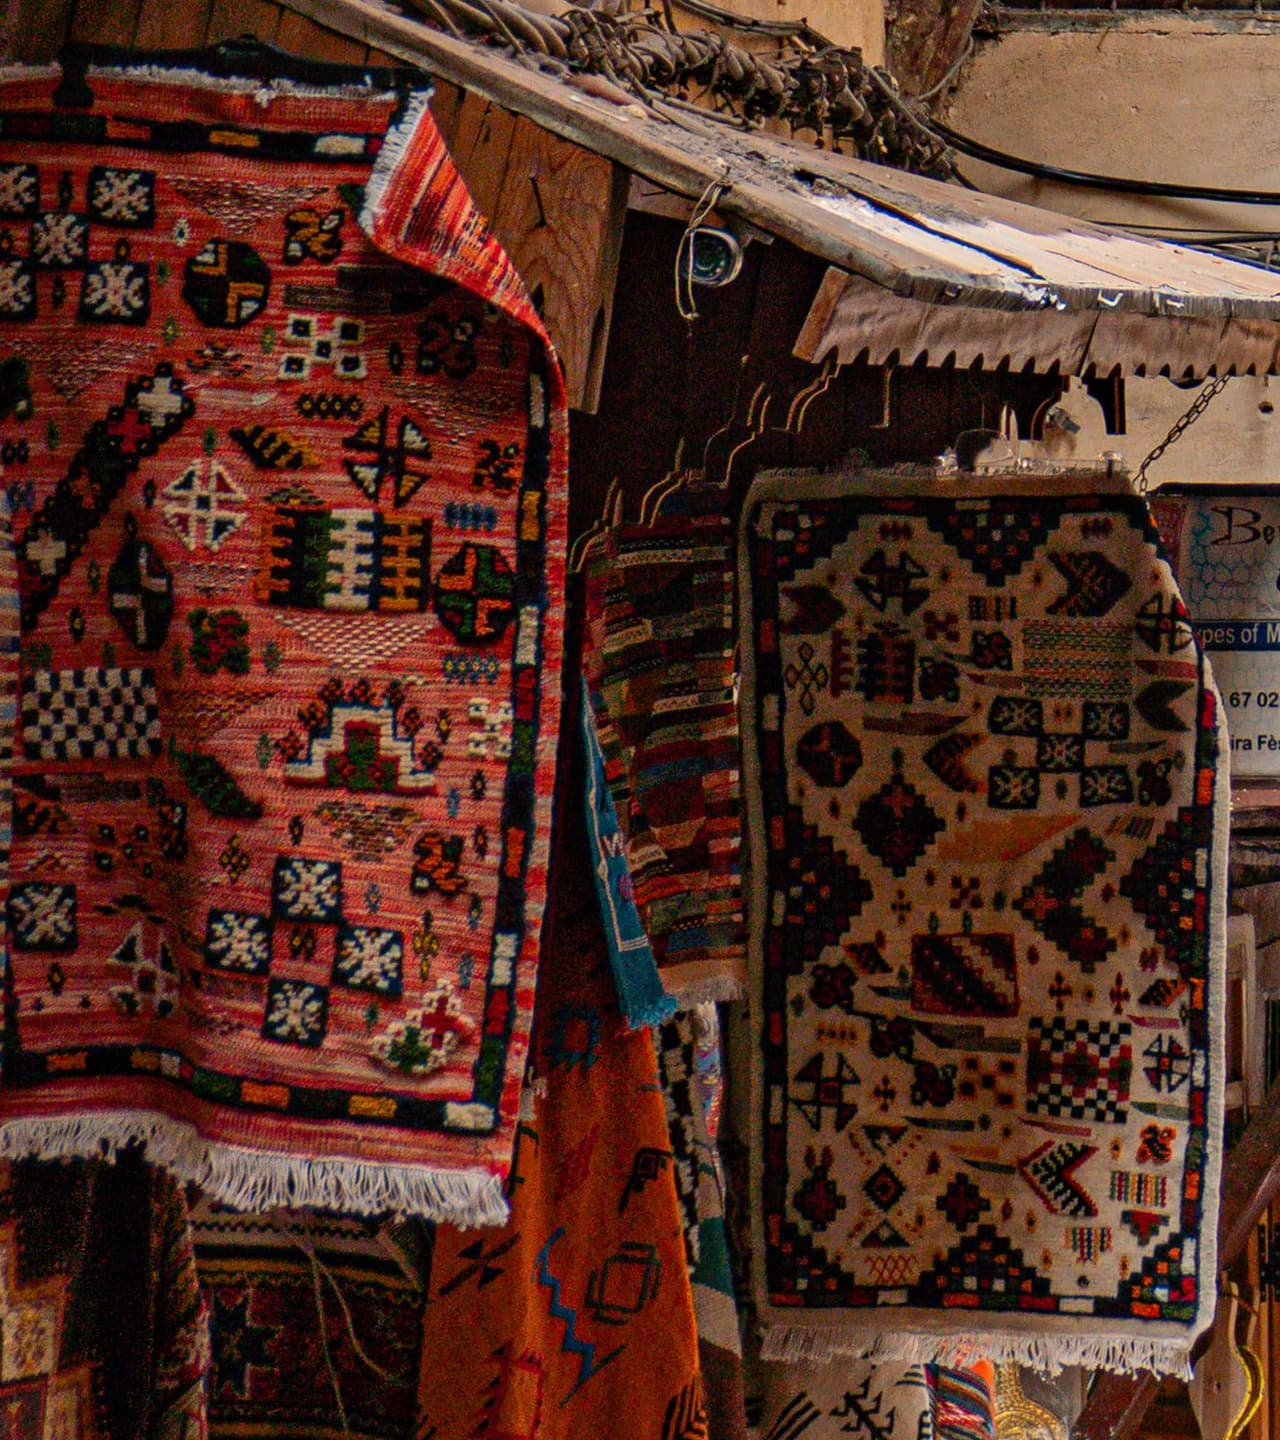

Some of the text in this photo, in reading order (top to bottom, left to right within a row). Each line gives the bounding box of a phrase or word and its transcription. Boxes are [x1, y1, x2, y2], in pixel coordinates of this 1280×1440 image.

[1199, 628, 1236, 649] pes
[1240, 623, 1259, 644] of
[1229, 692, 1252, 708] 67
[1256, 692, 1279, 708] 02
